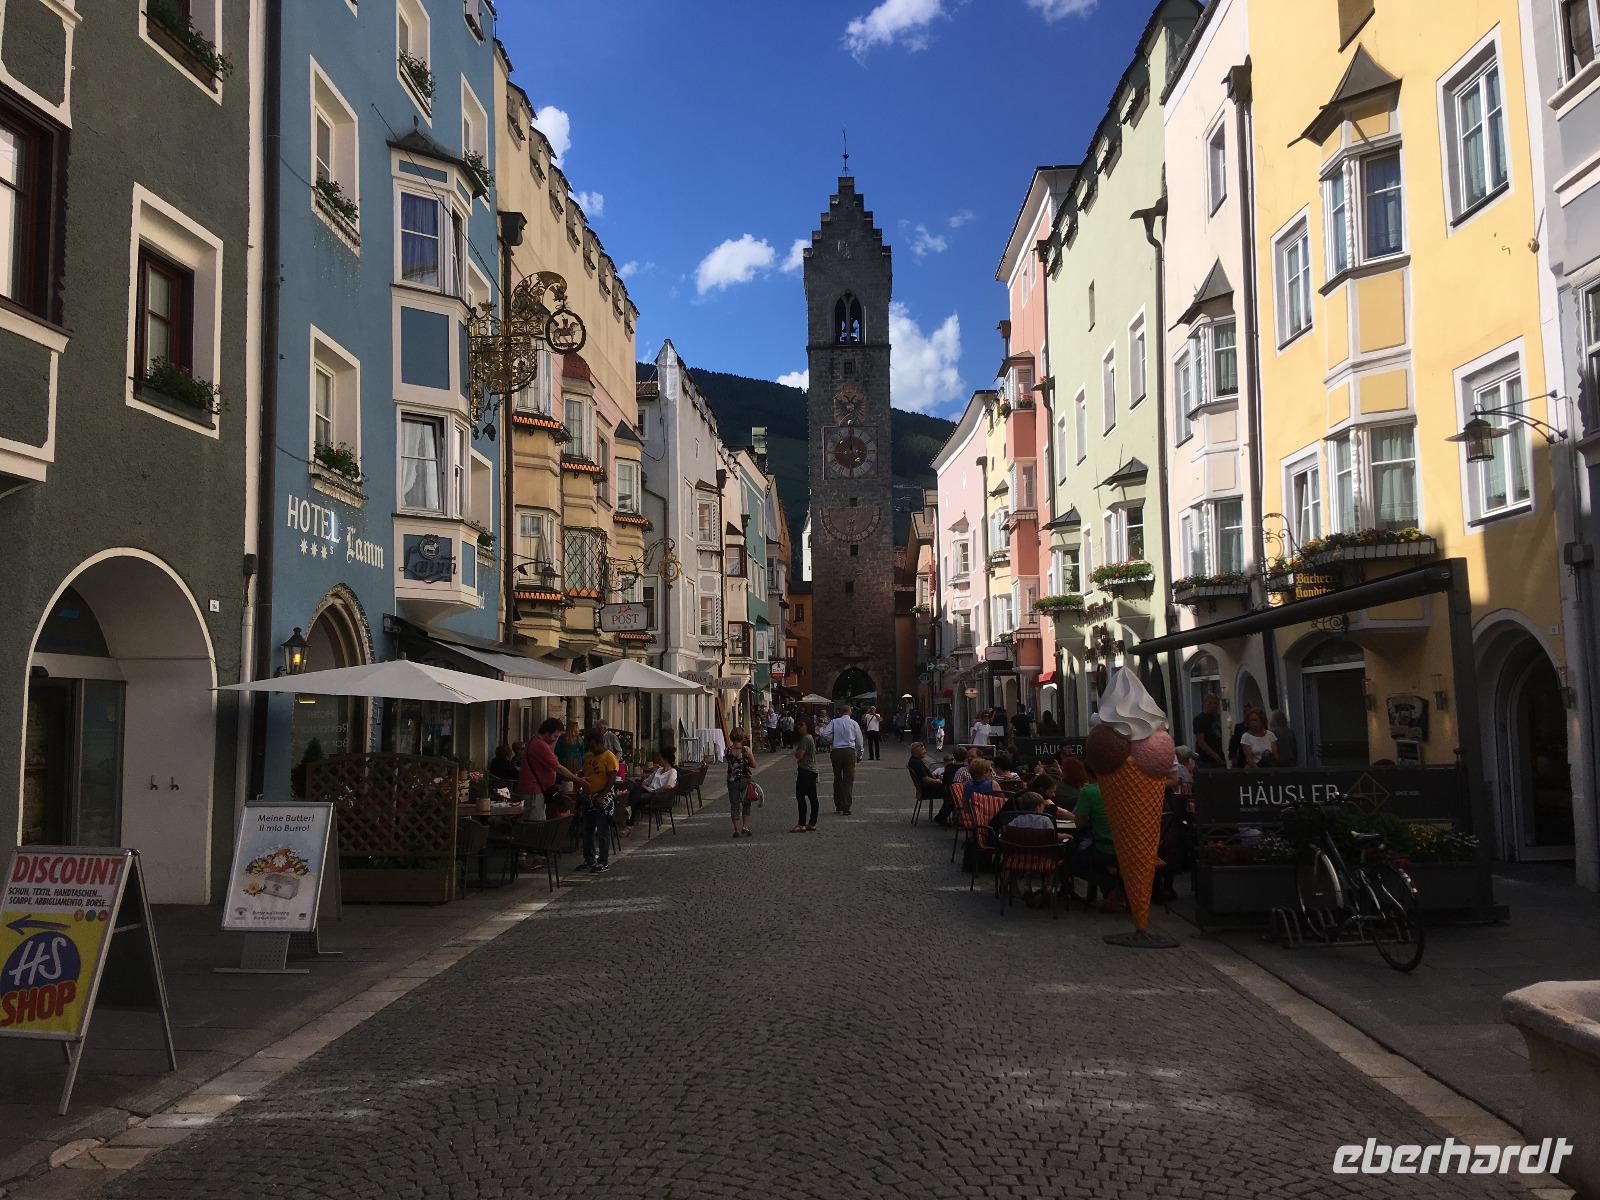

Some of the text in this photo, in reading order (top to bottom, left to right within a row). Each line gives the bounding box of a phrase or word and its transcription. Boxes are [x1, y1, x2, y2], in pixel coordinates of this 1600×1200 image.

[287, 494, 341, 544] HOTEL
[612, 613, 640, 625] POST
[257, 814, 315, 822] Meine Butter!
[12, 856, 123, 886] DISCOUNT
[8, 887, 30, 897] SCHUH,
[0, 980, 77, 1028] SHOP
